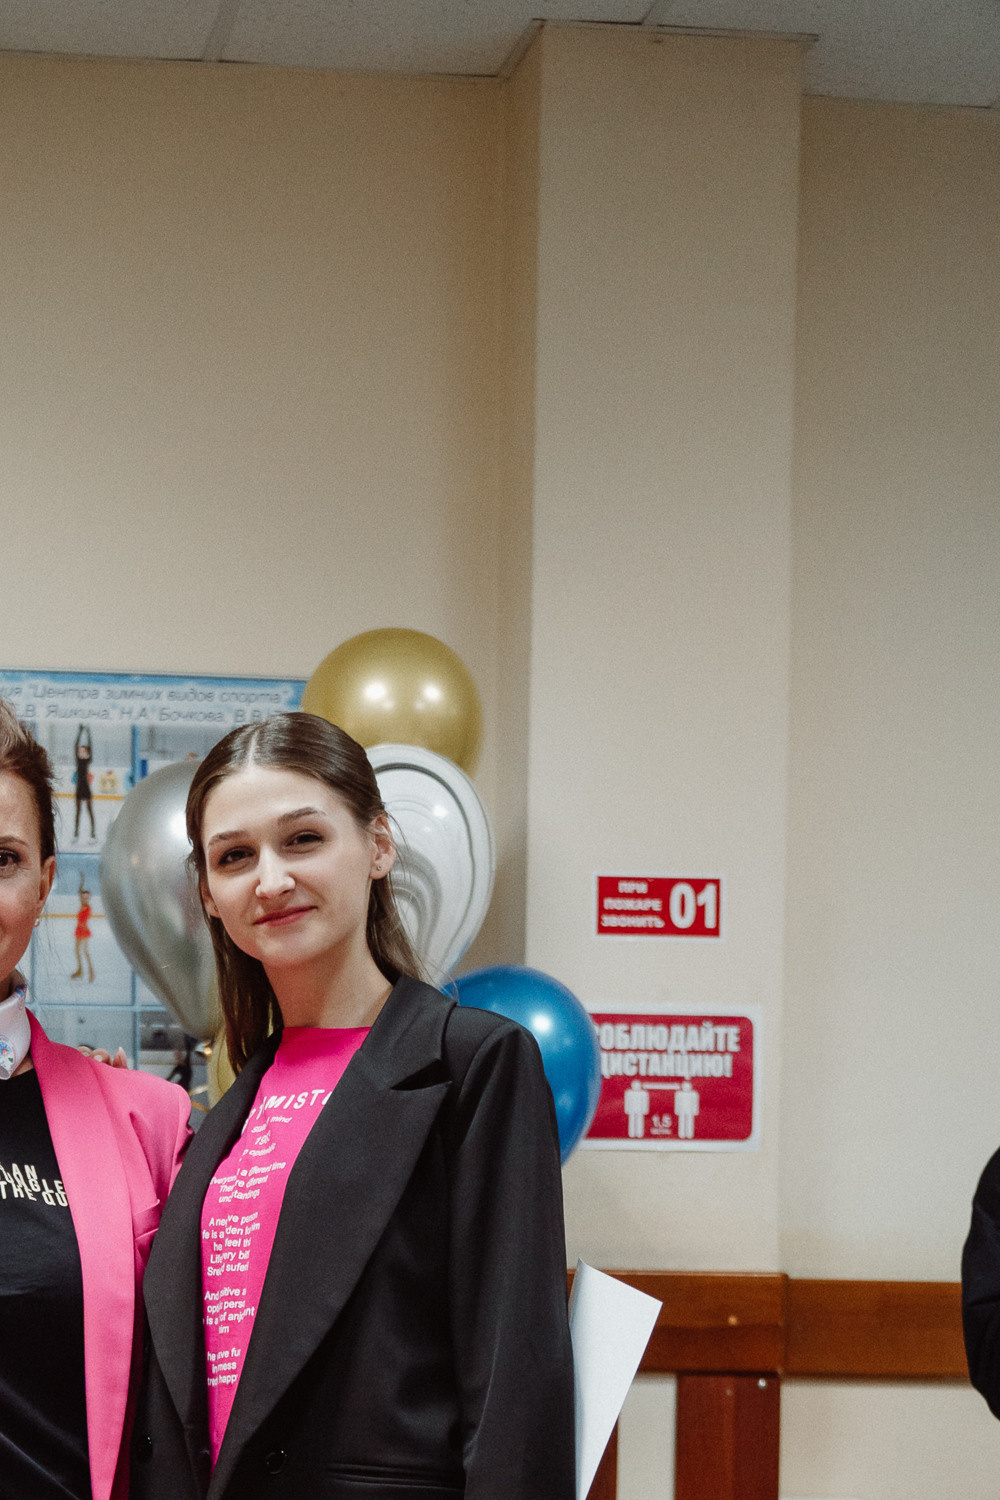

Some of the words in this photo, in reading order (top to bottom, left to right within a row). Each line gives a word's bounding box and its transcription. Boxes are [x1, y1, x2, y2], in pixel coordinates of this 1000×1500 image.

[618, 881, 648, 894] ПРИ
[603, 897, 663, 911] ПОЖАРЕ
[669, 882, 717, 929] 01
[601, 914, 665, 928] ЗВОНИТЬ
[12, 1163, 38, 1181] AN
